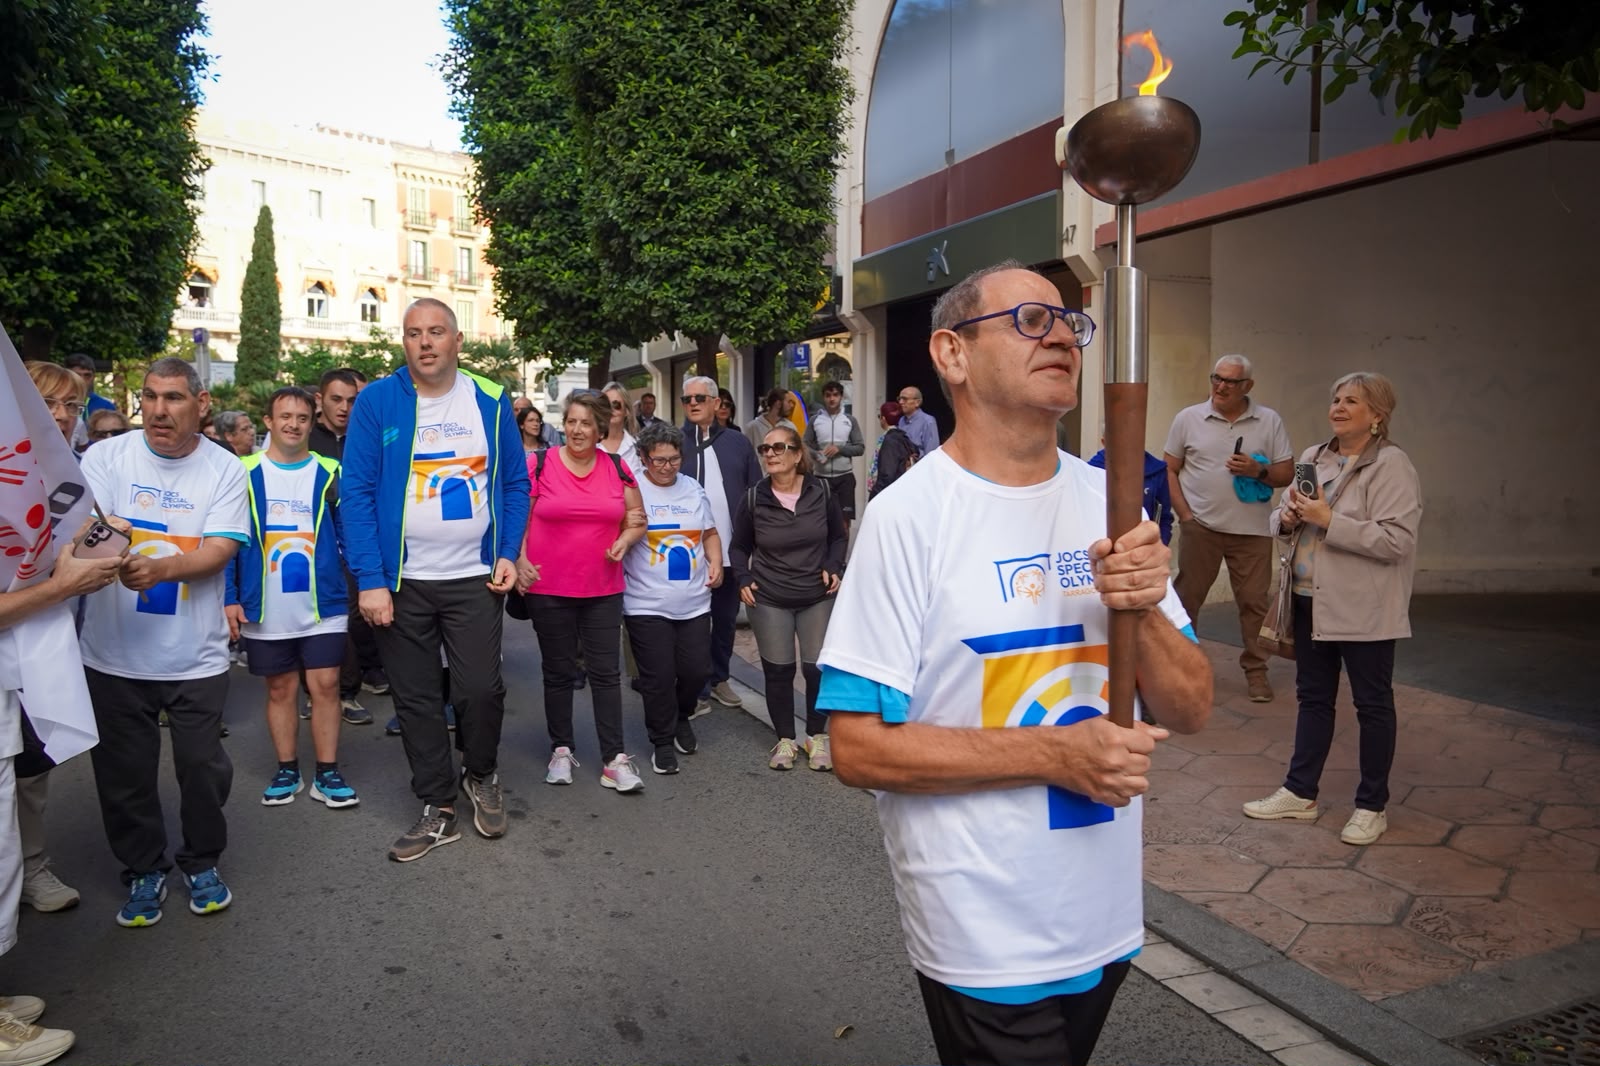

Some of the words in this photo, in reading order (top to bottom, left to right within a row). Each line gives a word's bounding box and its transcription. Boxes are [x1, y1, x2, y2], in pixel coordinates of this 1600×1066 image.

[1056, 550, 1089, 563] JOCS
[1057, 562, 1092, 576] SPEC
[1060, 574, 1094, 588] OLYM
